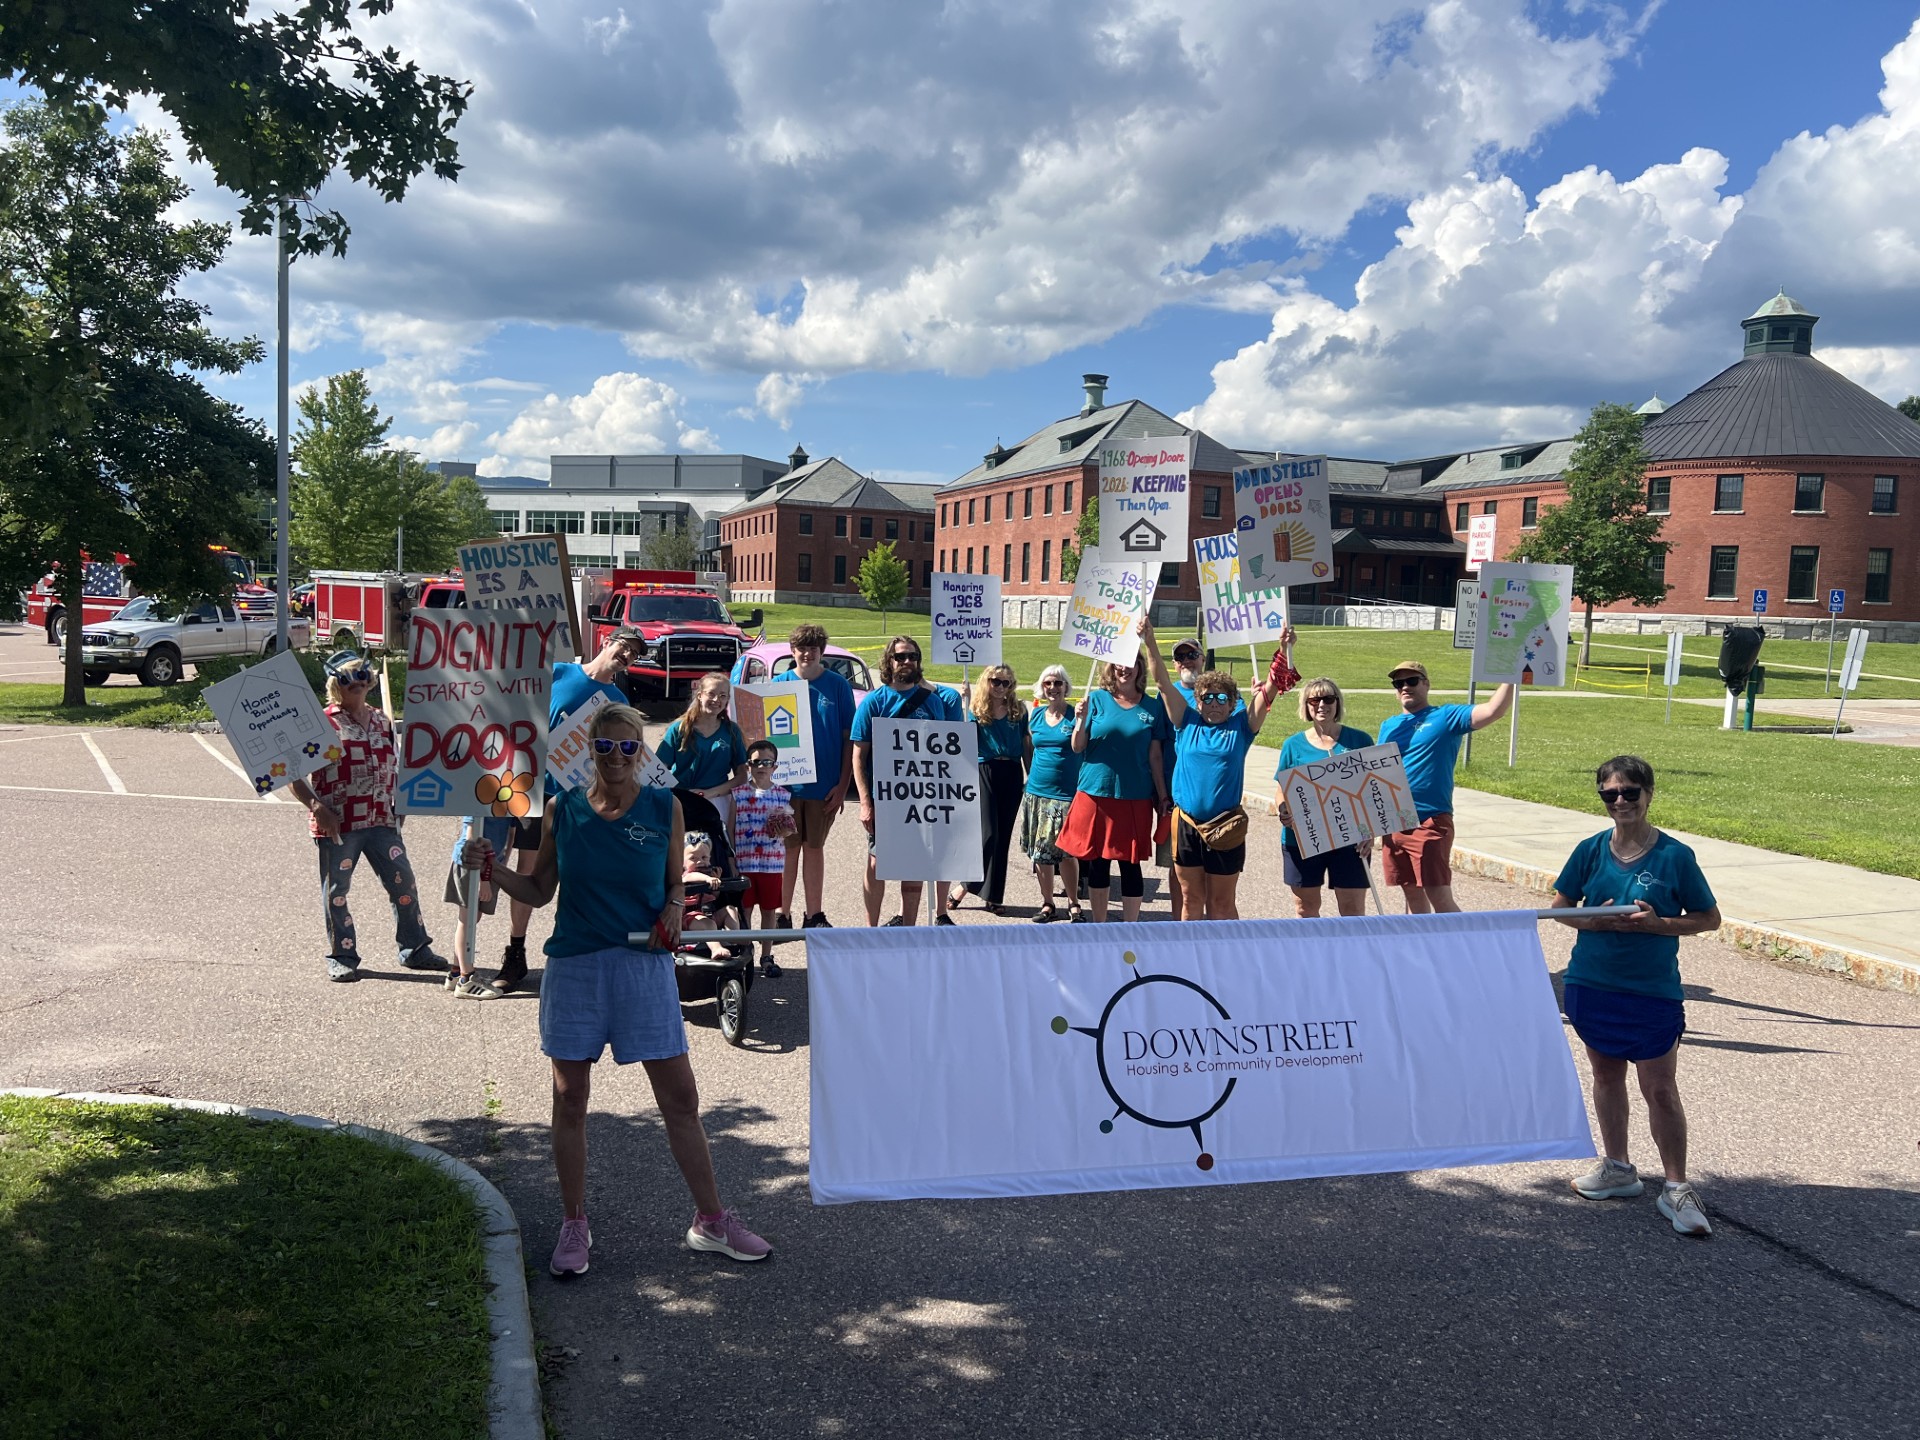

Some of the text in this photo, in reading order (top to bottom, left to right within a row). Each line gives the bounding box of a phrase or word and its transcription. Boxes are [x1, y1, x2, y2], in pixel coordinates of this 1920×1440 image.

[1128, 451, 1158, 468] Opening
[1132, 474, 1186, 493] KEEPING
[1234, 458, 1322, 494] DOWNSTREET
[1254, 482, 1303, 504] OPENS
[1116, 498, 1146, 512] Them
[1260, 499, 1302, 520] DOORS
[460, 542, 559, 572] HOUSING
[1195, 534, 1238, 562] HOUS
[476, 570, 539, 594] IS A
[1201, 562, 1218, 584] IS
[943, 581, 984, 595] Honoring
[1098, 582, 1142, 612] Today
[1462, 586, 1472, 594] NO
[1507, 580, 1526, 592] Fair
[950, 594, 982, 608] 1968
[935, 612, 990, 628] Continuing
[1072, 614, 1118, 639] Justice
[1074, 596, 1130, 635] Housing
[1207, 600, 1266, 634] RIGHT
[408, 616, 557, 672] DIGNITY
[944, 630, 992, 640] the Work
[1075, 634, 1112, 654] For All
[241, 690, 280, 713] Homes
[408, 678, 542, 704] STARTS WITH
[248, 706, 298, 730] Opportunity
[251, 702, 280, 718] Build
[470, 704, 486, 721] A
[404, 720, 538, 778] DOOR
[892, 728, 962, 755] 1968
[894, 760, 952, 778] FAIR
[1307, 752, 1363, 781] DOWN
[1340, 754, 1400, 780] STREET
[878, 781, 976, 802] HOUSING
[904, 804, 954, 824] ACT
[1370, 779, 1390, 834] COMMUNITY
[1330, 796, 1350, 842] HOMES
[1122, 1020, 1356, 1060] DOWNSTREET
[1126, 1053, 1363, 1076] Housing & Community Development
